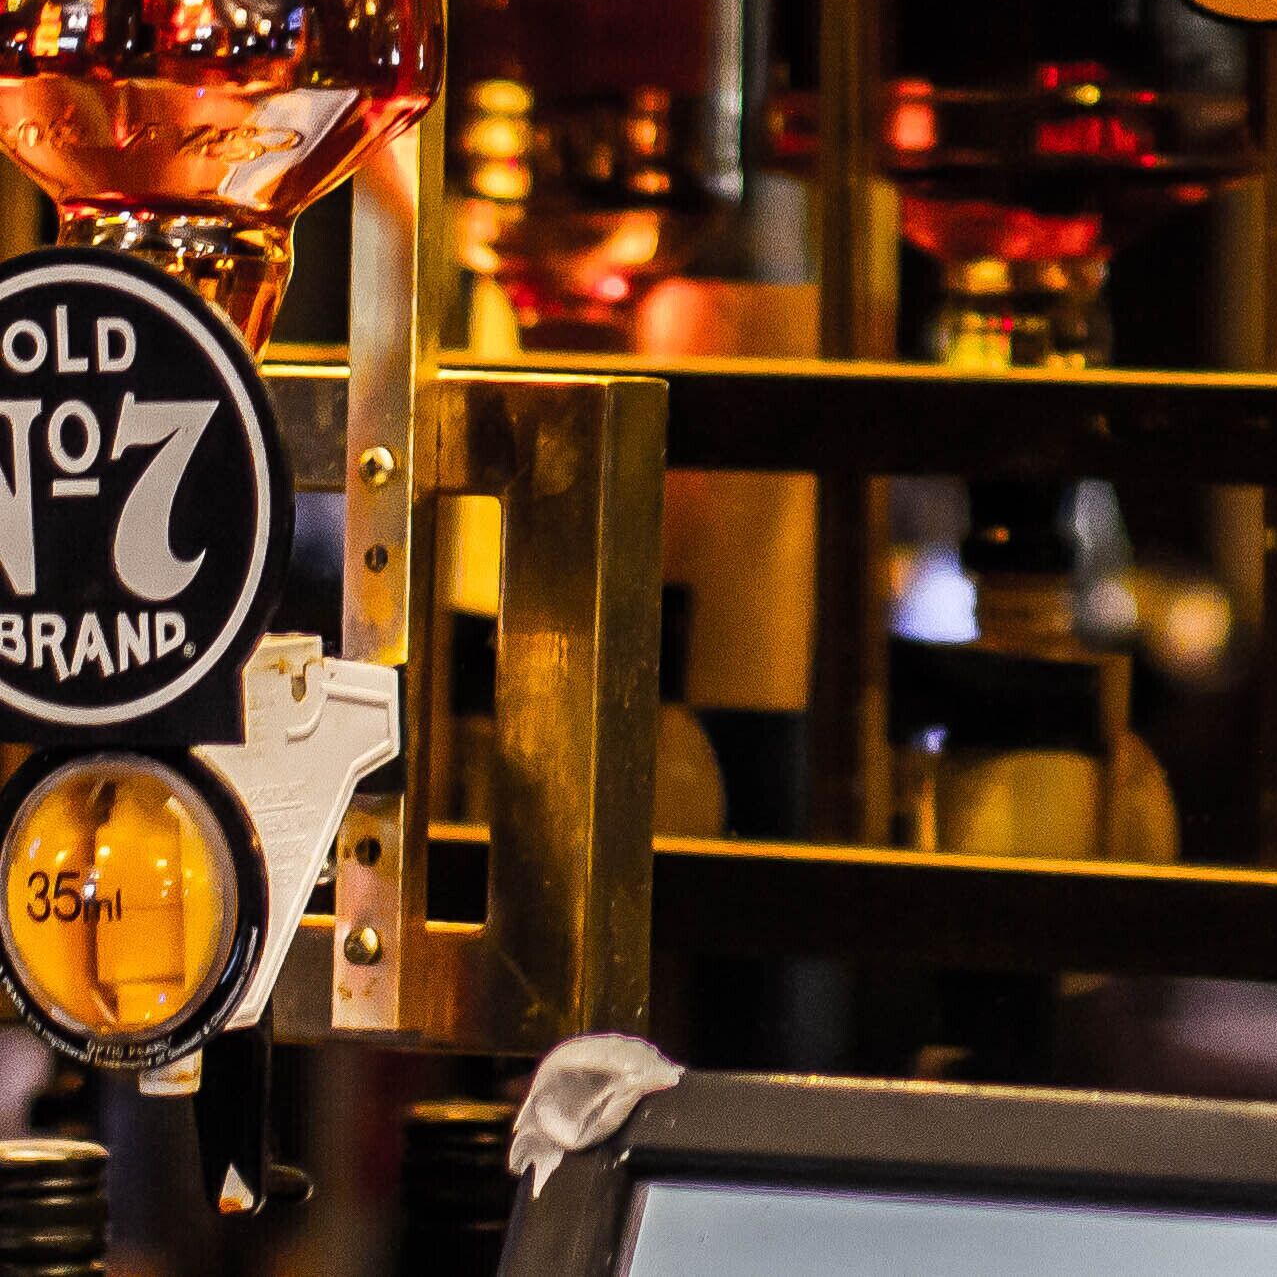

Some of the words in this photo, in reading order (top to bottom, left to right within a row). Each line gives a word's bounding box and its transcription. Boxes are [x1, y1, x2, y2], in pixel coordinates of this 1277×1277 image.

[3, 305, 136, 374] OLD
[0, 611, 186, 683] BRAND
[27, 870, 122, 922] 35ml
